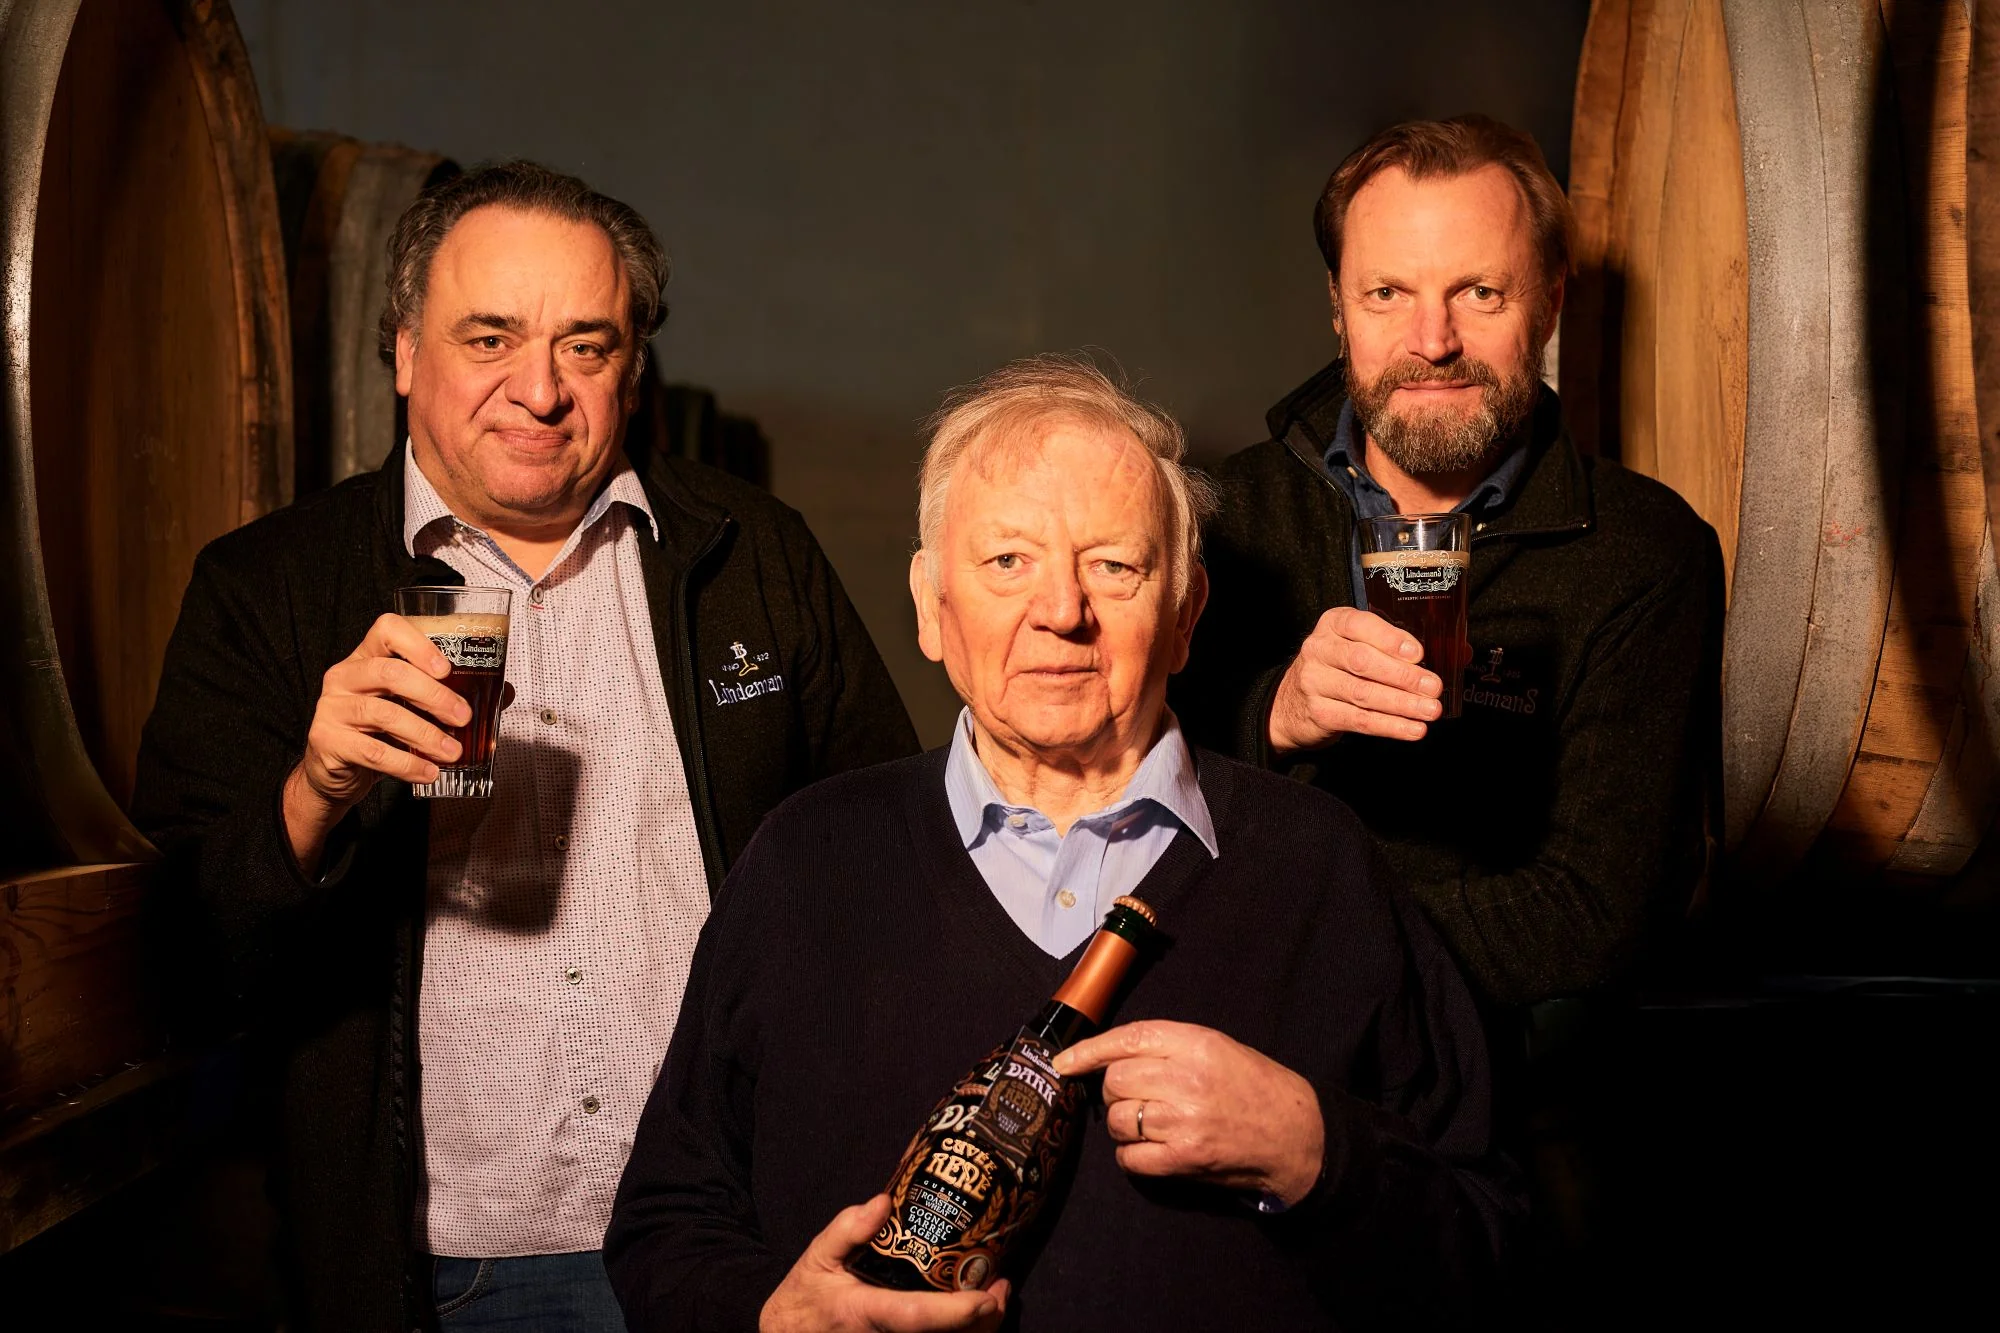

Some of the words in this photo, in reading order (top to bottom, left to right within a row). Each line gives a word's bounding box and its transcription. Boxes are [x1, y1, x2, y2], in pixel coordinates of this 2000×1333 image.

[1004, 1062, 1057, 1107] DARK
[921, 1191, 959, 1216] ROASTED
[923, 1180, 968, 1207] GUEUZE
[909, 1205, 954, 1234] COGNAC
[925, 1200, 950, 1217] WHEAT
[908, 1213, 947, 1241] BARREL
[910, 1224, 939, 1244] AGED
